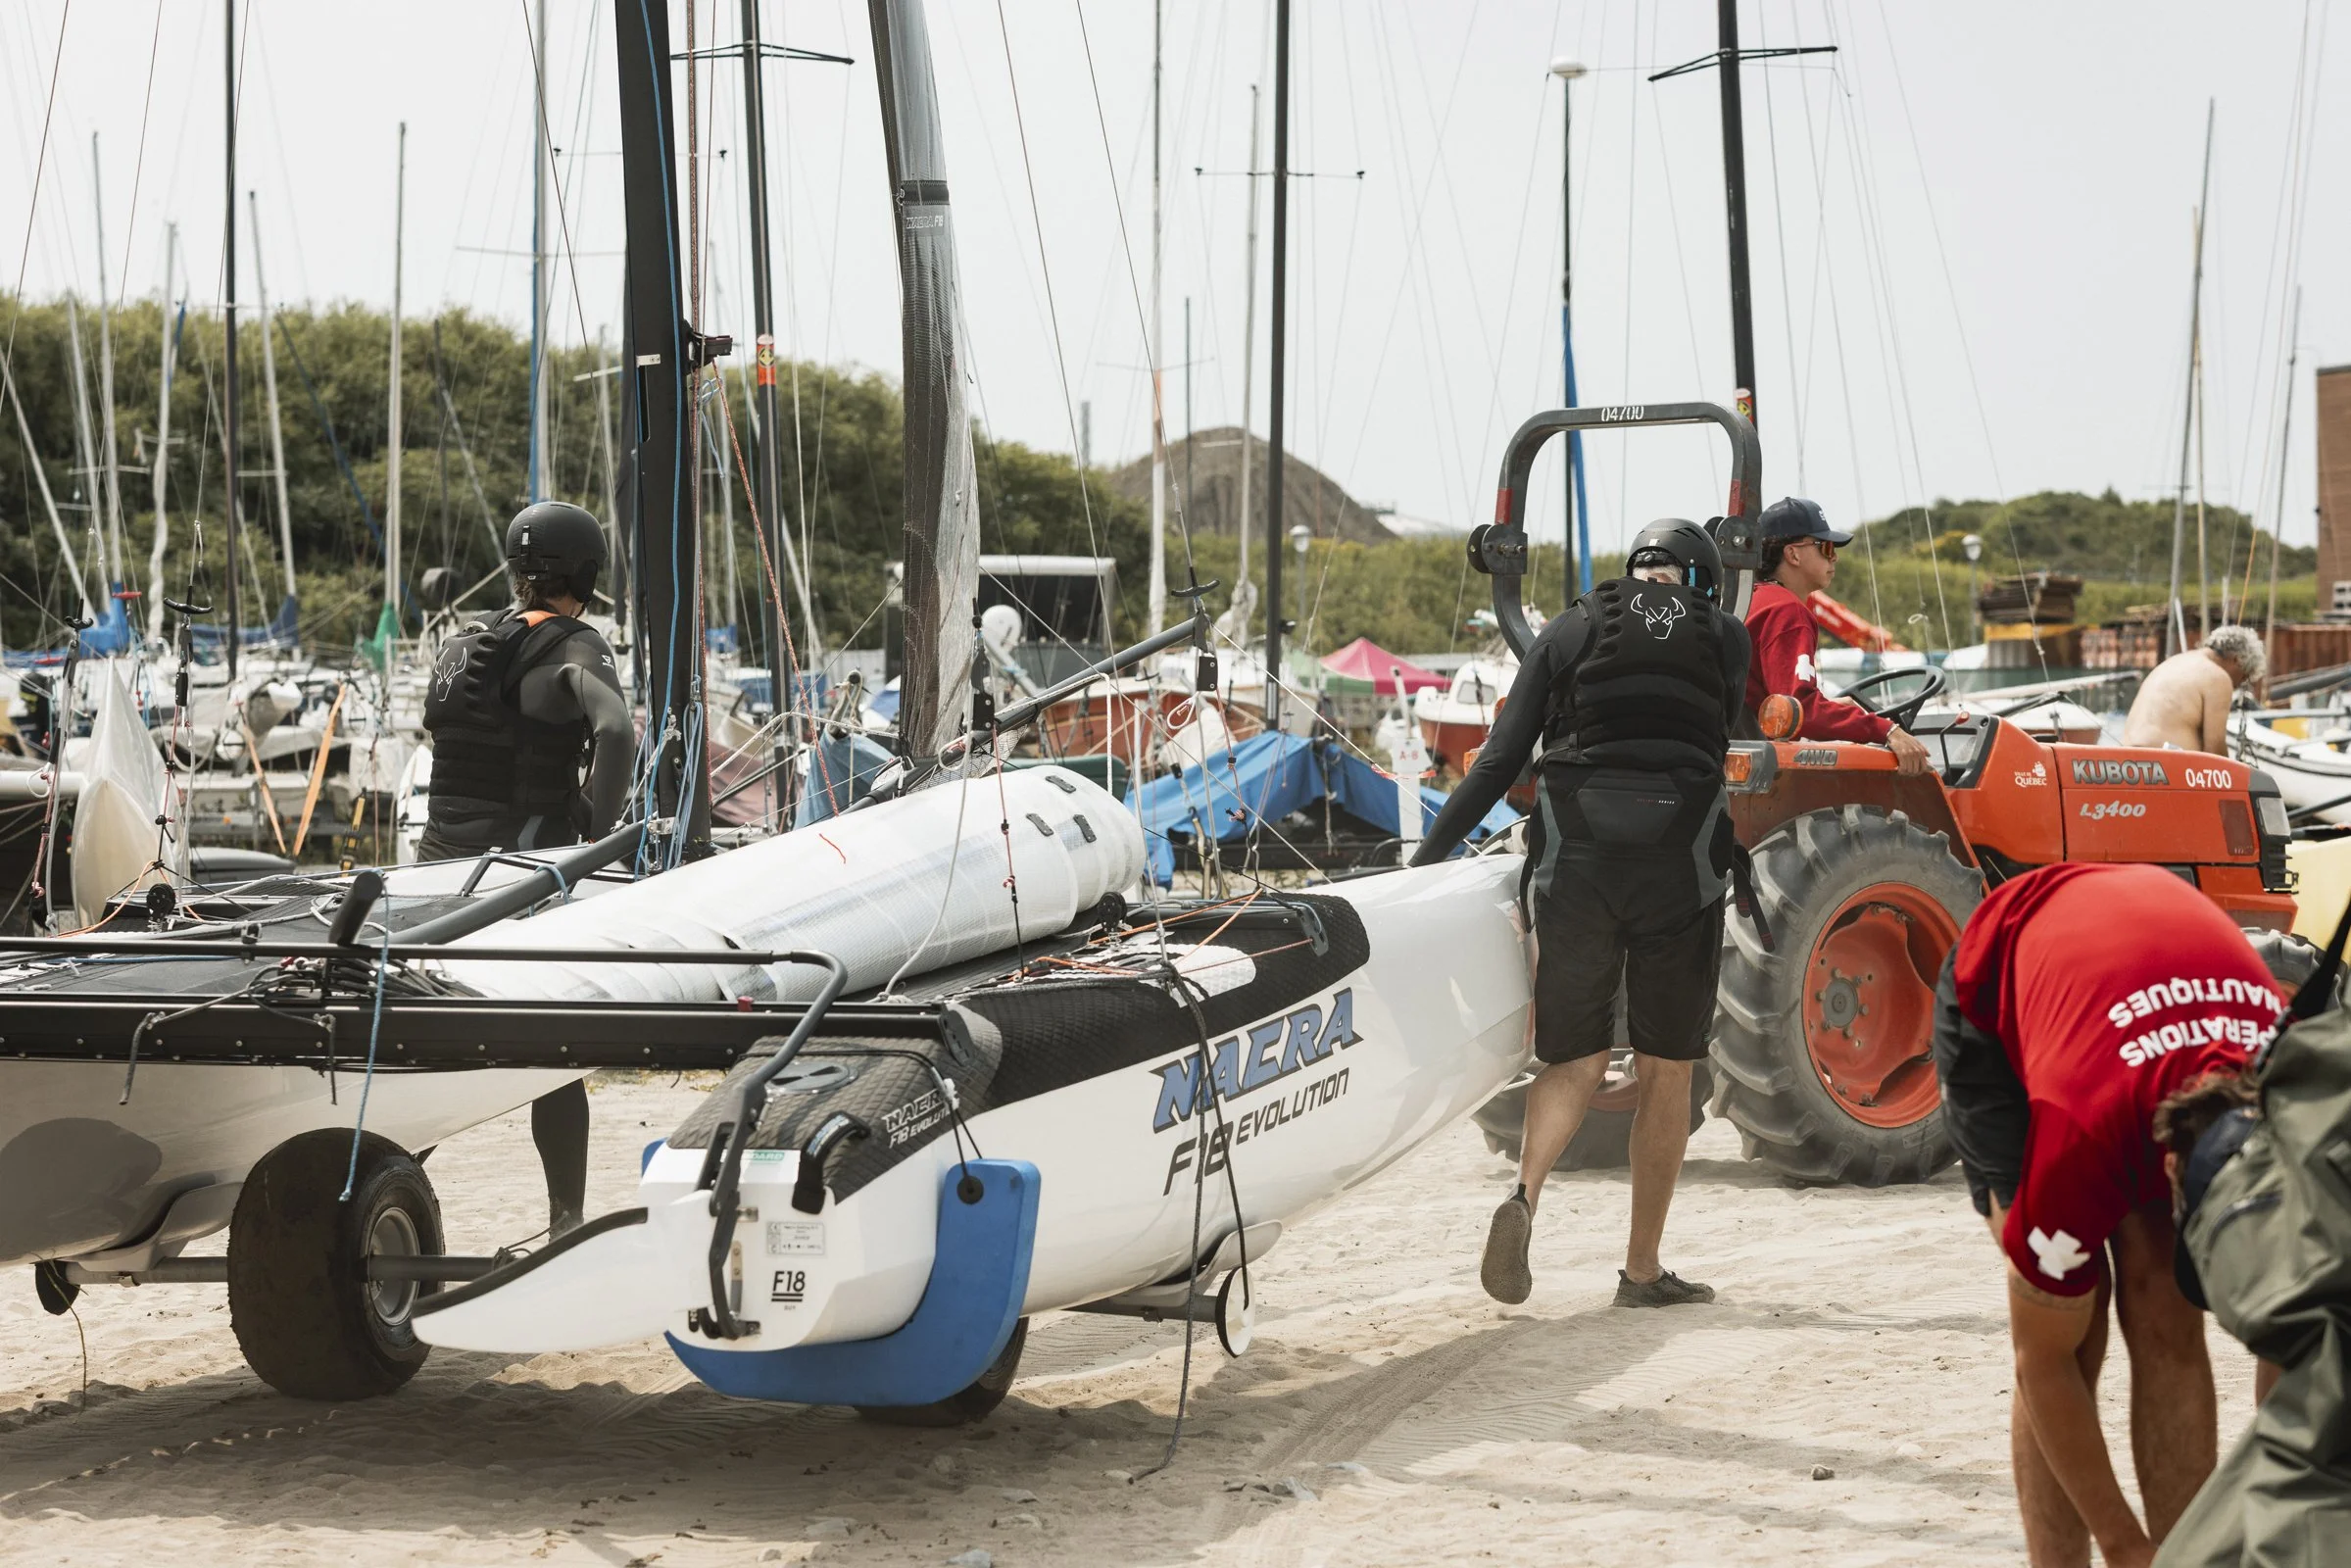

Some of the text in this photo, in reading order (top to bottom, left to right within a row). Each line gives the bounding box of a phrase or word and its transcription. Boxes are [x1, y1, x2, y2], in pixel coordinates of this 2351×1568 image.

[1792, 749, 1838, 766] 4WD
[2072, 759, 2170, 785] KUBOTA
[2184, 768, 2232, 790] 04700
[2080, 800, 2147, 820] L3400
[2107, 977, 2283, 1028] NAUTIQUES
[2119, 1015, 2279, 1068] PÉRATIONS
[1148, 987, 1365, 1135] NACRA
[1236, 1066, 1350, 1147] EVOLUTION
[772, 1270, 807, 1293] F18
